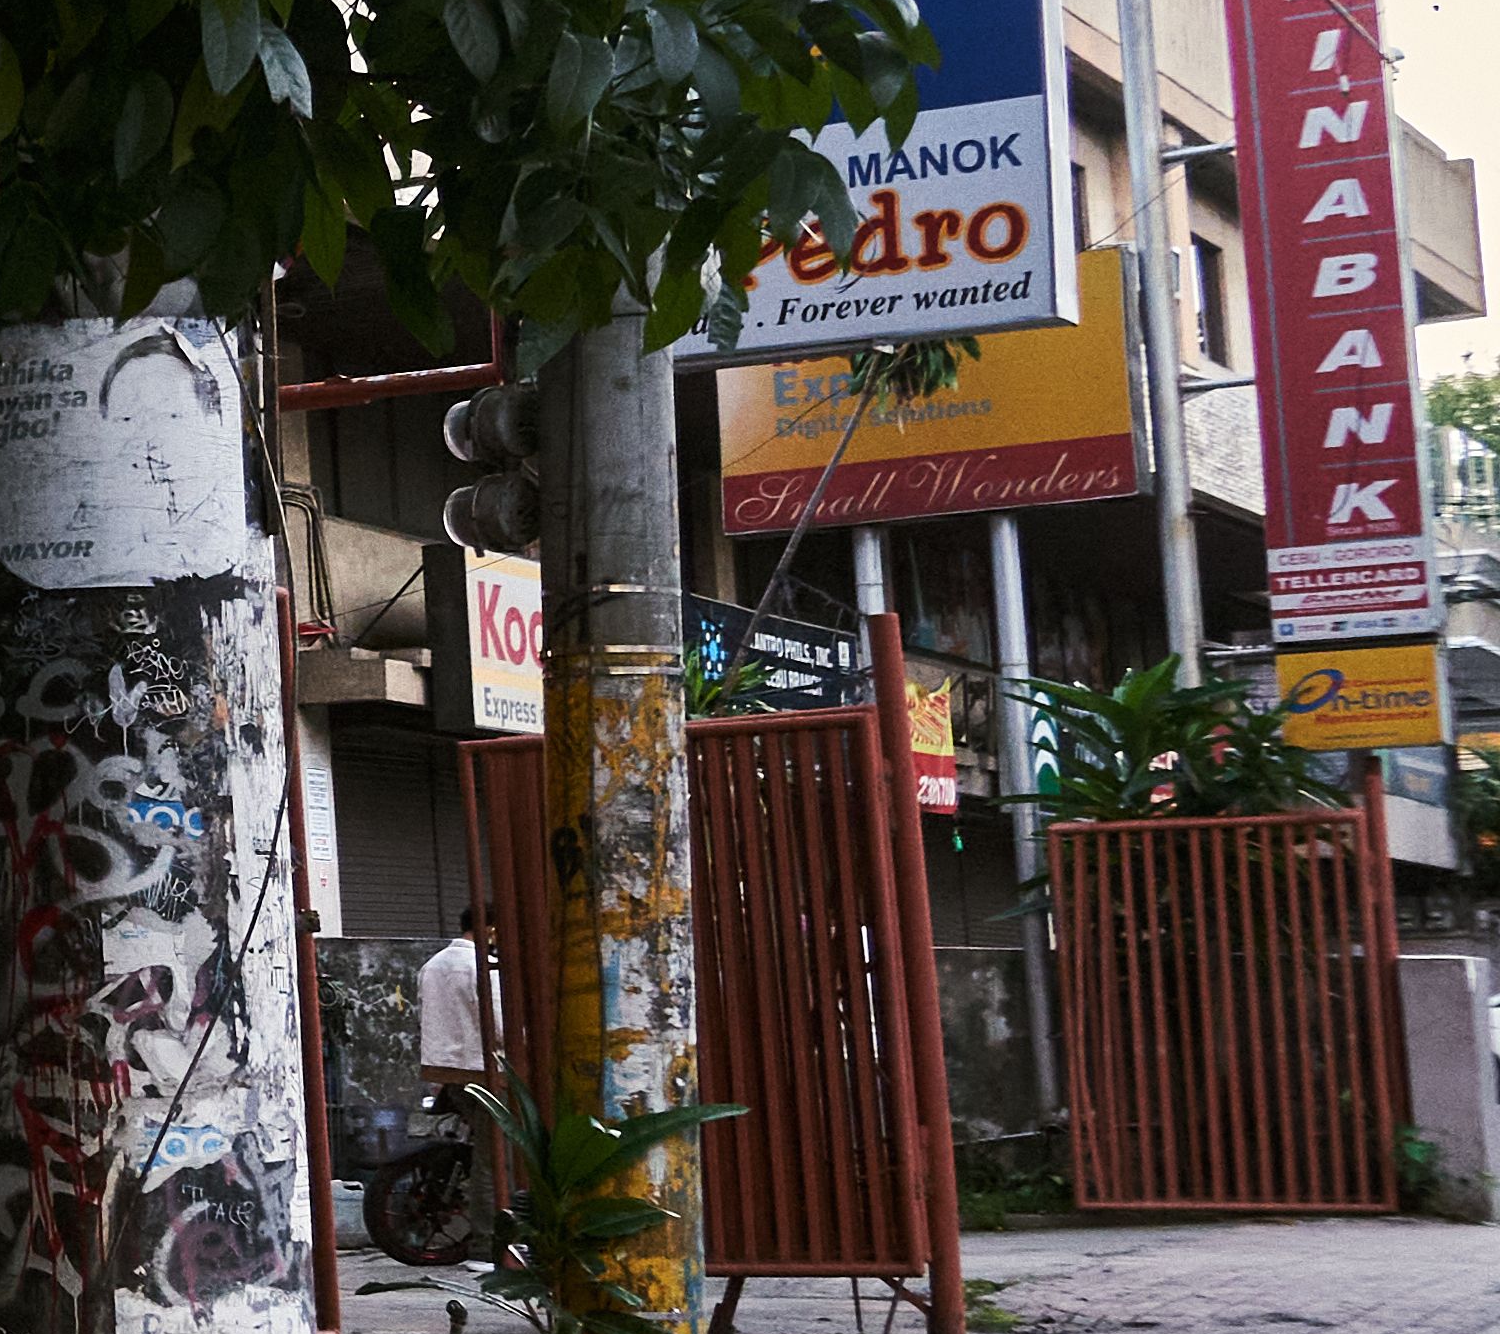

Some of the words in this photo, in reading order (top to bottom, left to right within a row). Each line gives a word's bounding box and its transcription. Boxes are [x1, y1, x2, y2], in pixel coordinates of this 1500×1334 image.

[847, 132, 1023, 189] MANOK
[777, 293, 905, 326] Forever
[912, 271, 1033, 311] wanted
[57, 389, 89, 408] sa
[906, 452, 1121, 509] Wonders
[0, 539, 95, 563] MAYOR
[1274, 566, 1421, 590] TELLERCARD
[483, 686, 537, 727] Express
